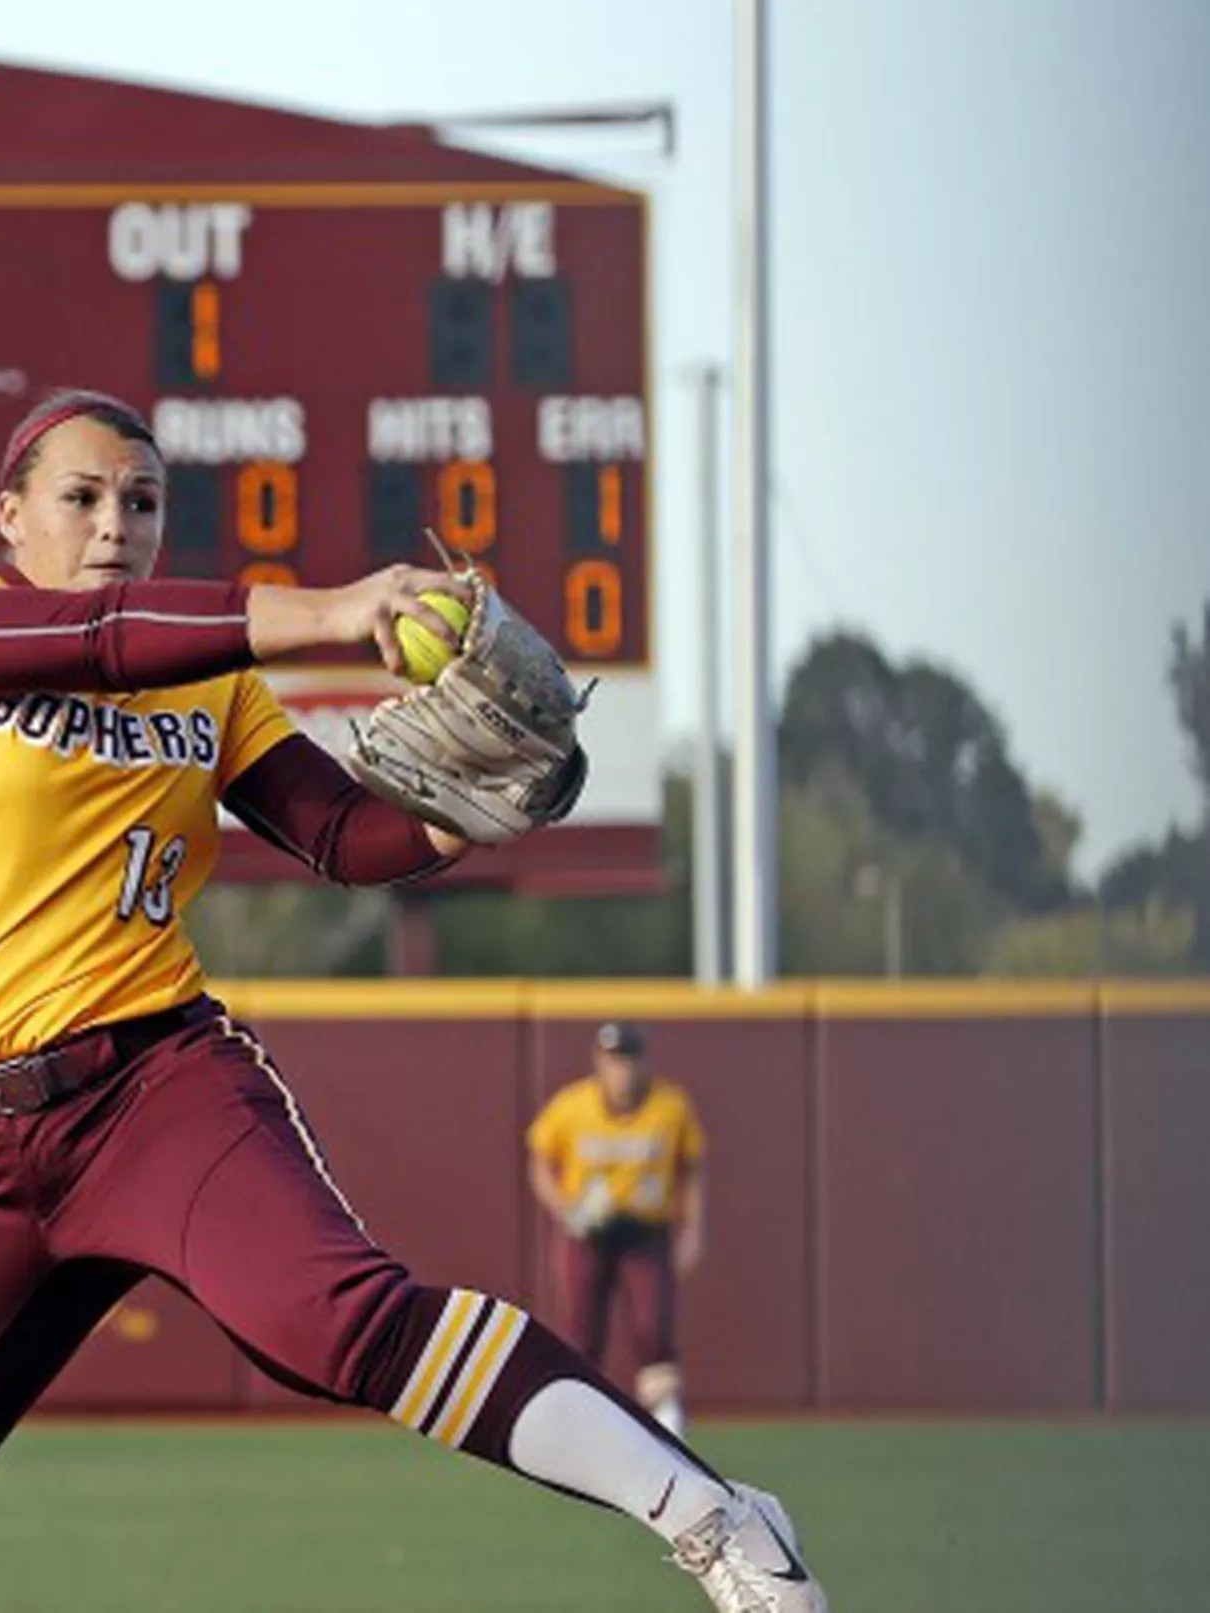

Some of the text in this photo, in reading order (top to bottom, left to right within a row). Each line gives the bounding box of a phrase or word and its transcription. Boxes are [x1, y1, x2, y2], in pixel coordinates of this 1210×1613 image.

[109, 202, 251, 281] OUT
[442, 200, 555, 284] H/E
[192, 282, 220, 379] 1
[154, 401, 306, 462] RUNS
[368, 398, 493, 463] HITS
[537, 398, 646, 463] ERR
[237, 462, 298, 554] 0
[438, 460, 497, 552] 0
[599, 466, 623, 545] 1
[566, 560, 623, 657] 0
[116, 826, 186, 928] 13
